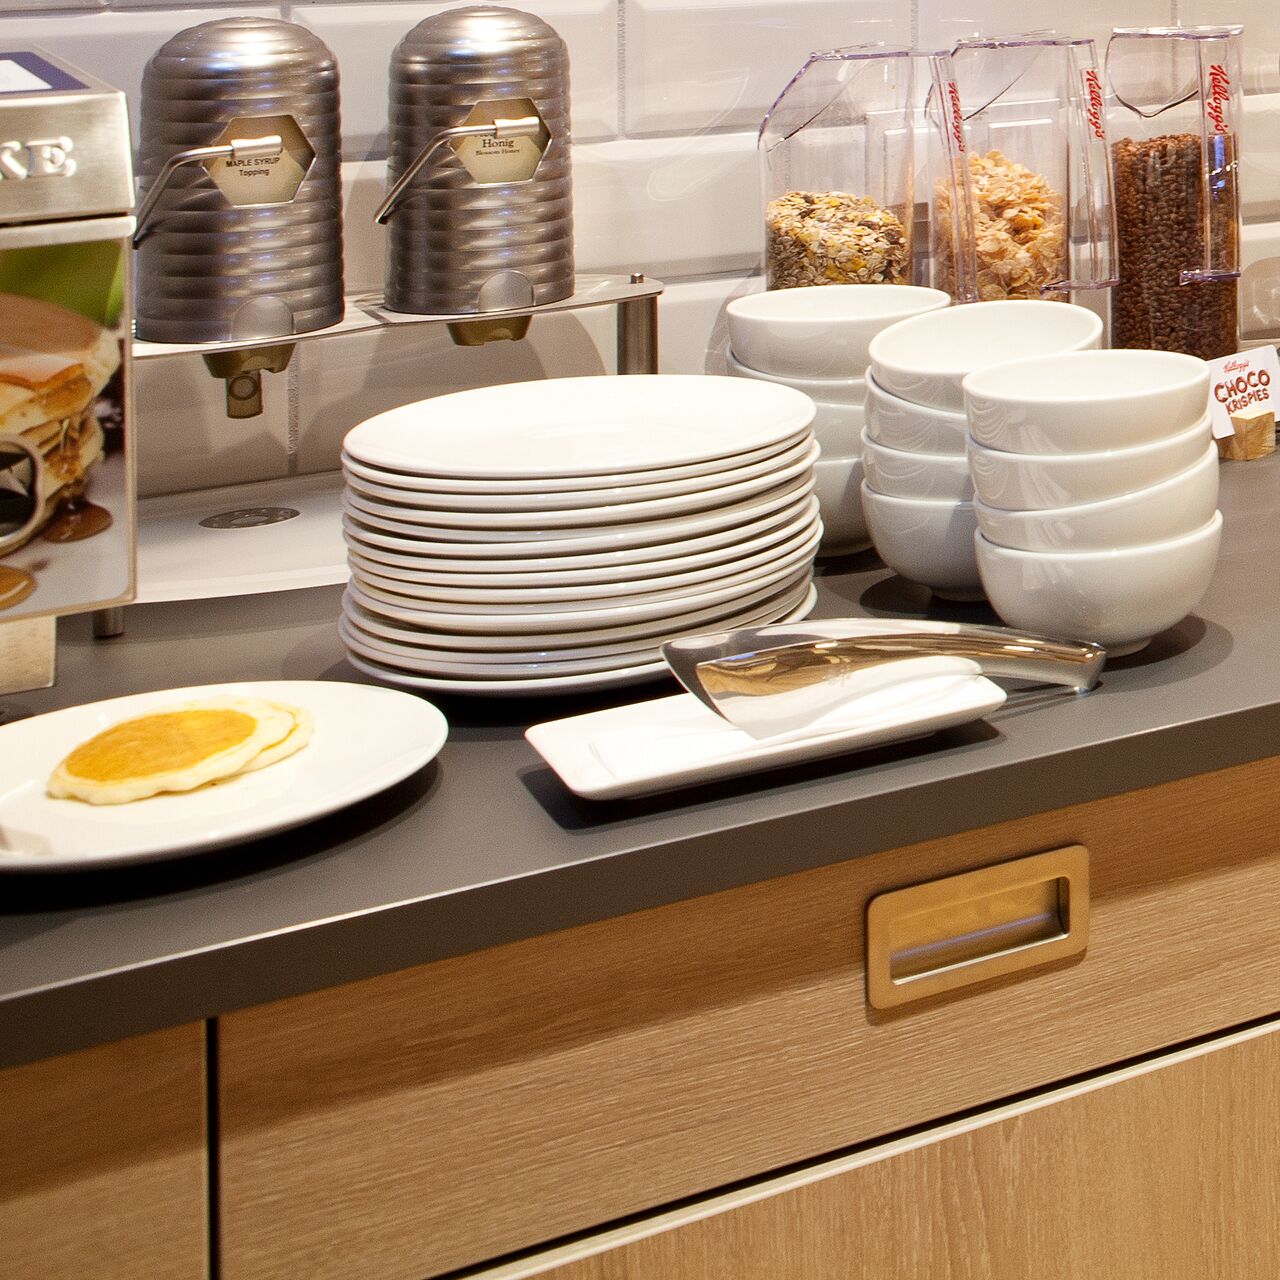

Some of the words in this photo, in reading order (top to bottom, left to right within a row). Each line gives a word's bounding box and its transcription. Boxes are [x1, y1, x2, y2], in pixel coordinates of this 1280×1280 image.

[1086, 70, 1106, 142] Kellogg's
[1207, 64, 1230, 134] Kellogg's
[482, 138, 514, 148] Honig
[225, 159, 252, 168] MAPLE
[254, 156, 280, 166] SYRUP
[239, 169, 269, 177] Topping
[1214, 369, 1270, 403] CHOCO
[1225, 388, 1270, 415] KRISPIES
